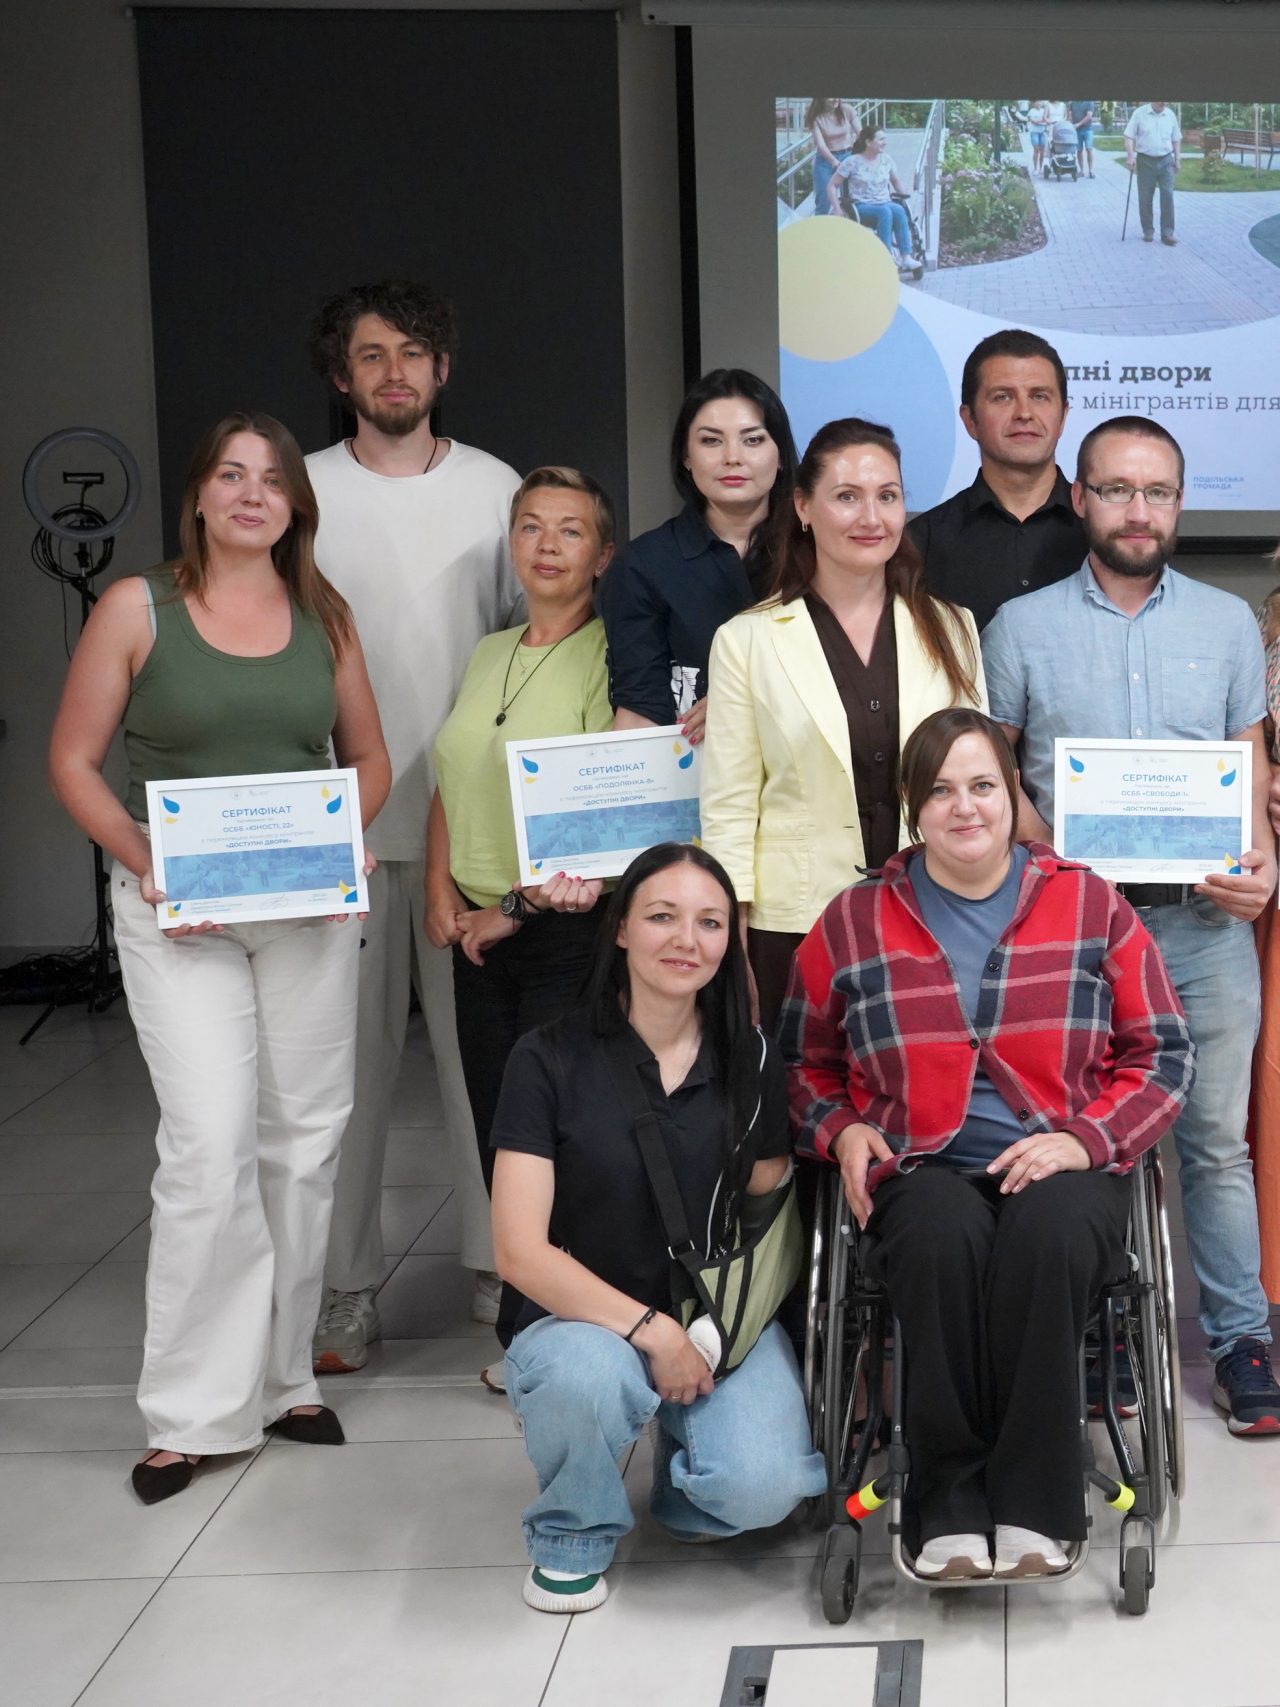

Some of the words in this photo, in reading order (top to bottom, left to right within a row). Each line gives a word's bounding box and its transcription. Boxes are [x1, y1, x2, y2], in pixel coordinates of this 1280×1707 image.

[1065, 360, 1111, 381] пні
[1119, 366, 1212, 388] двори
[1083, 392, 1229, 416] мінігрантів
[579, 762, 646, 776] СЕРТИФІКАТ
[1122, 774, 1188, 782] СЕРТИФІКАТ
[222, 806, 292, 818] СЕРТИФІКАТ
